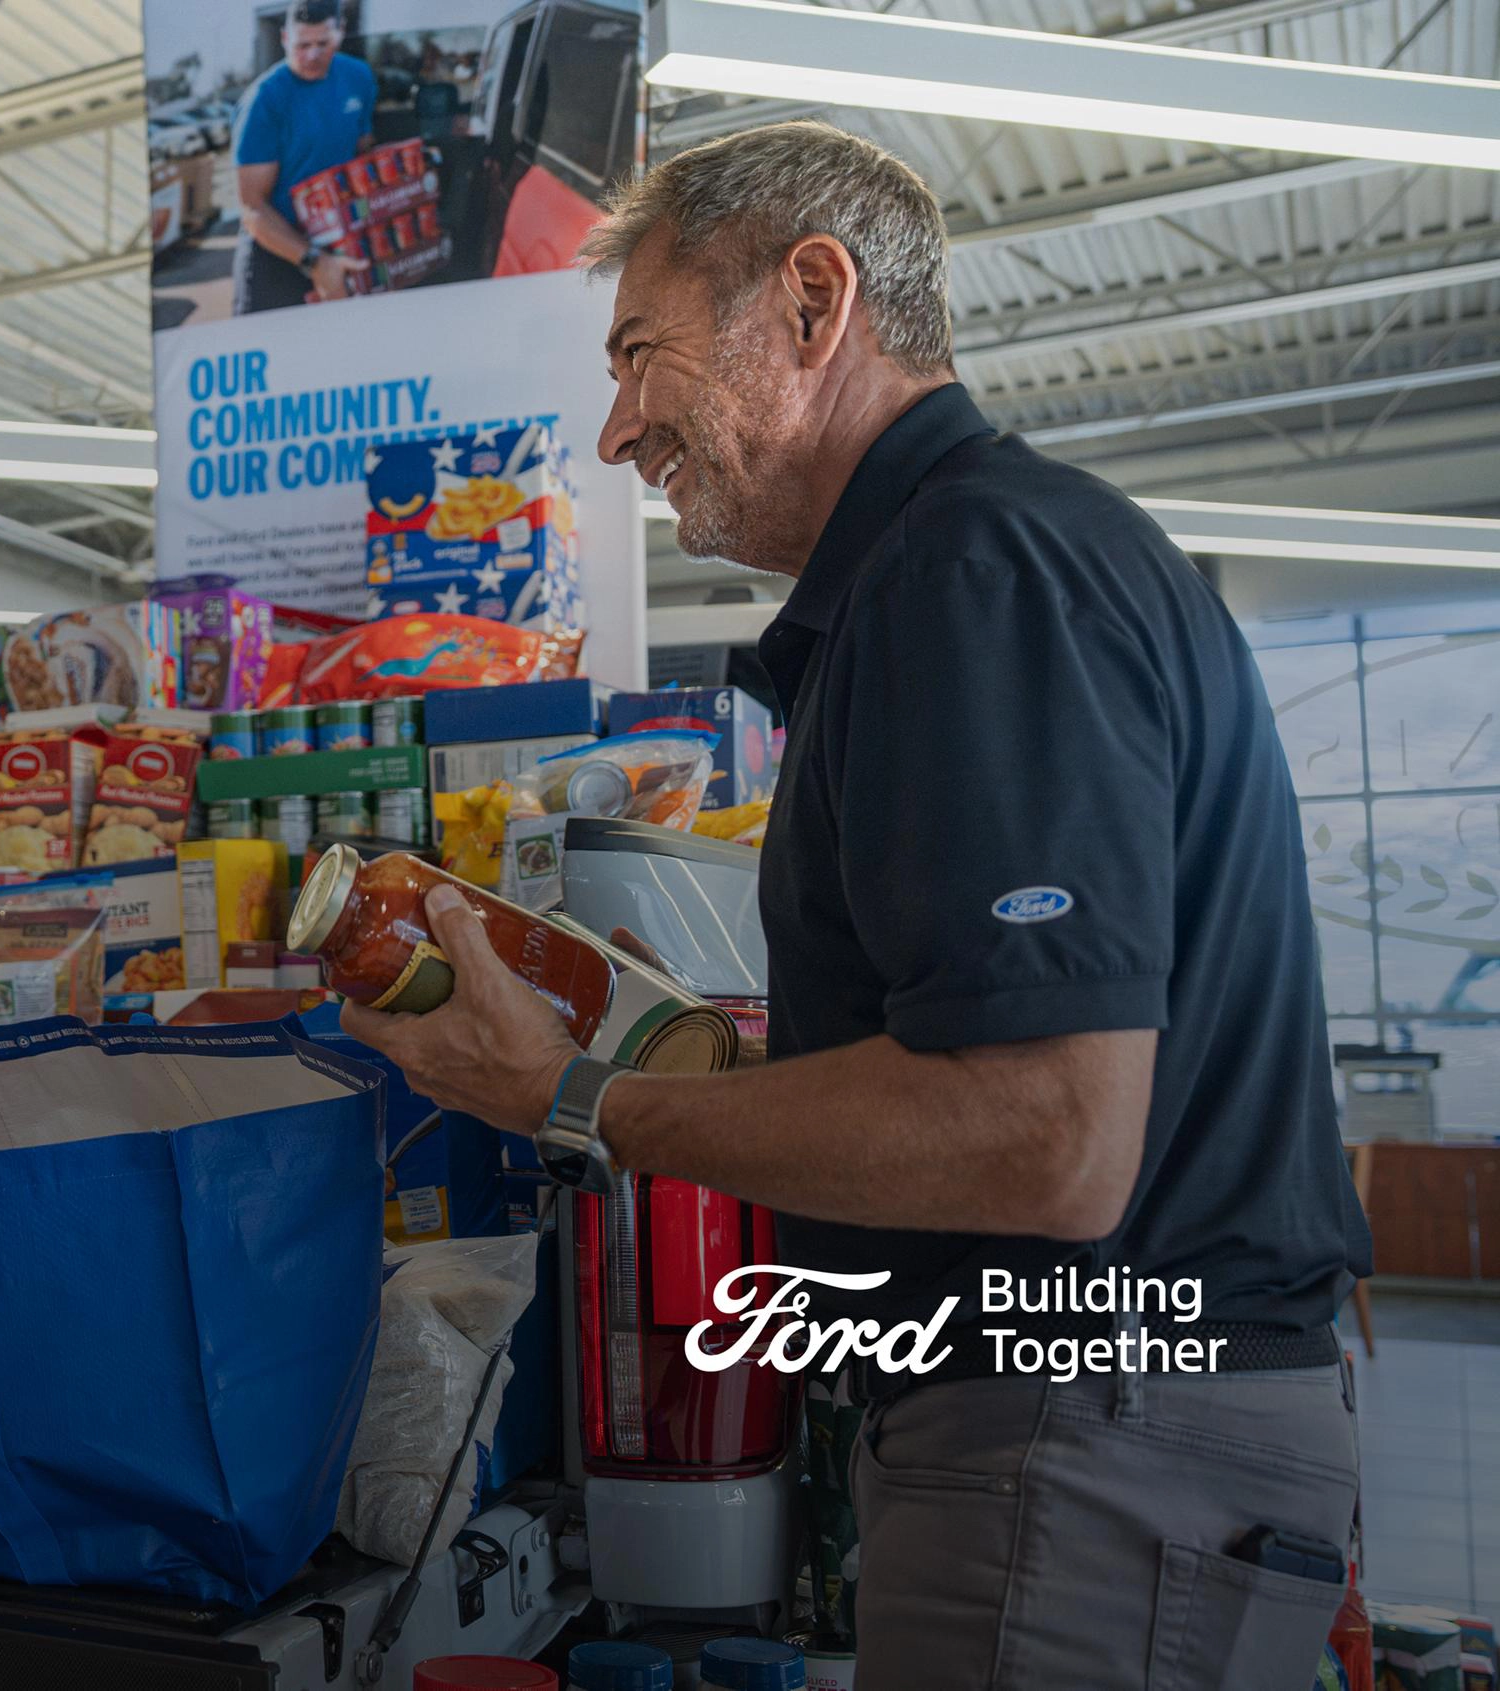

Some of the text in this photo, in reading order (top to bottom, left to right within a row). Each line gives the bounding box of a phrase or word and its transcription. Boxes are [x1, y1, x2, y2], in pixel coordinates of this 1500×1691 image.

[187, 350, 268, 402] OUR
[188, 375, 440, 451] COMMUNITY.
[187, 449, 268, 501] OUR
[713, 690, 732, 715] 6
[1008, 893, 1057, 917] Ford
